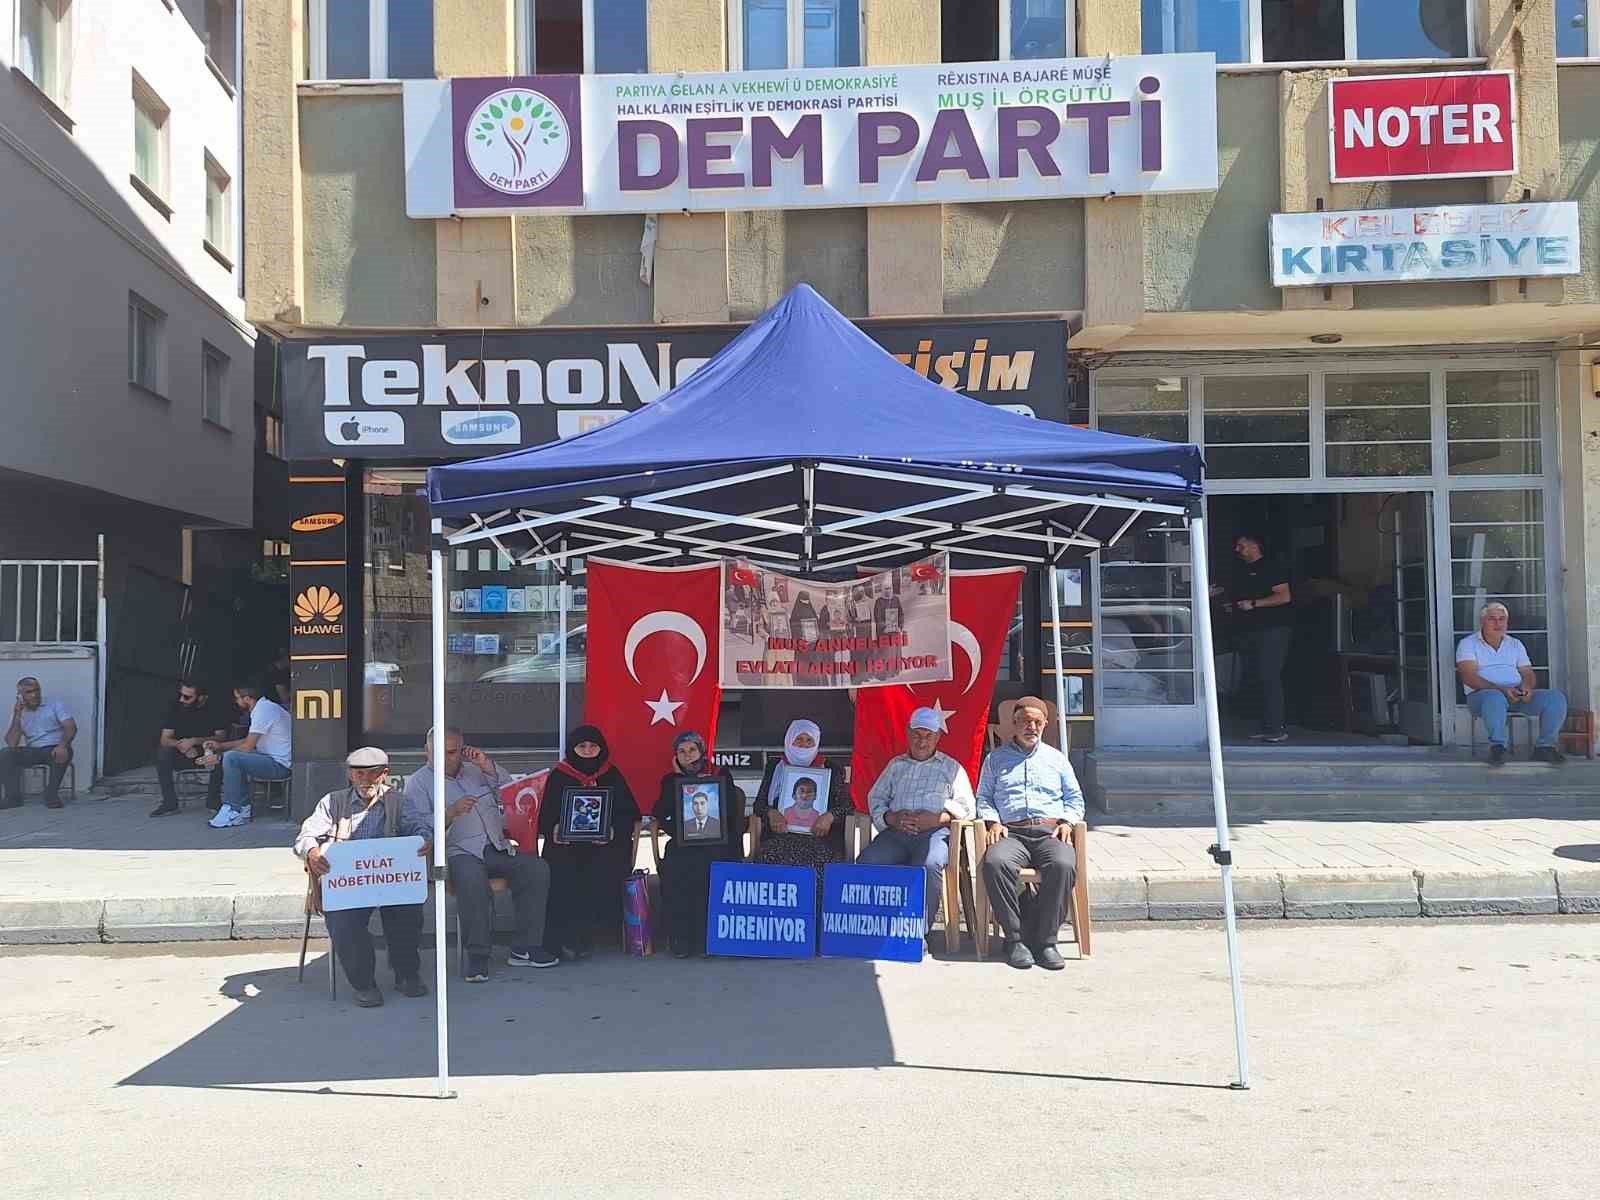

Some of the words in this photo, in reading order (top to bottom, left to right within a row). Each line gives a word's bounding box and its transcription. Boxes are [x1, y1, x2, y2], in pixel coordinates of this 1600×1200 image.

[616, 84, 667, 97] PARTIYA
[671, 83, 714, 96] GELAN
[719, 82, 728, 94] A
[938, 91, 984, 110] MUŞ
[992, 88, 1010, 106] İL
[1018, 84, 1112, 104] ÖRGÜTÜ
[617, 103, 692, 115] HALKLARIN
[695, 99, 744, 115] EŞİTLİK
[747, 100, 764, 112] VE
[767, 95, 842, 111] DEMOKRASİ
[848, 93, 898, 109] PARTİSİ
[616, 114, 824, 192] DEM
[857, 76, 1163, 185] PARTİ
[1343, 102, 1504, 149] NOTER
[489, 171, 513, 188] DEM
[515, 169, 549, 189] PARTİ
[1281, 234, 1569, 276] KIRTASİYE
[361, 425, 389, 433] iPhone
[455, 423, 508, 433] SAMSUNG
[293, 624, 343, 635] HUAWEI
[355, 858, 393, 870] EVLAT
[328, 870, 422, 889] NÖBETİNDEYİZ
[722, 880, 798, 907] ANNELER
[840, 883, 871, 905] ARTIK
[874, 884, 902, 907] YETER
[718, 908, 806, 943] DİRENİYOR
[823, 912, 888, 937] YAKAMIZDAN
[890, 912, 924, 944] DÜŞÜN
